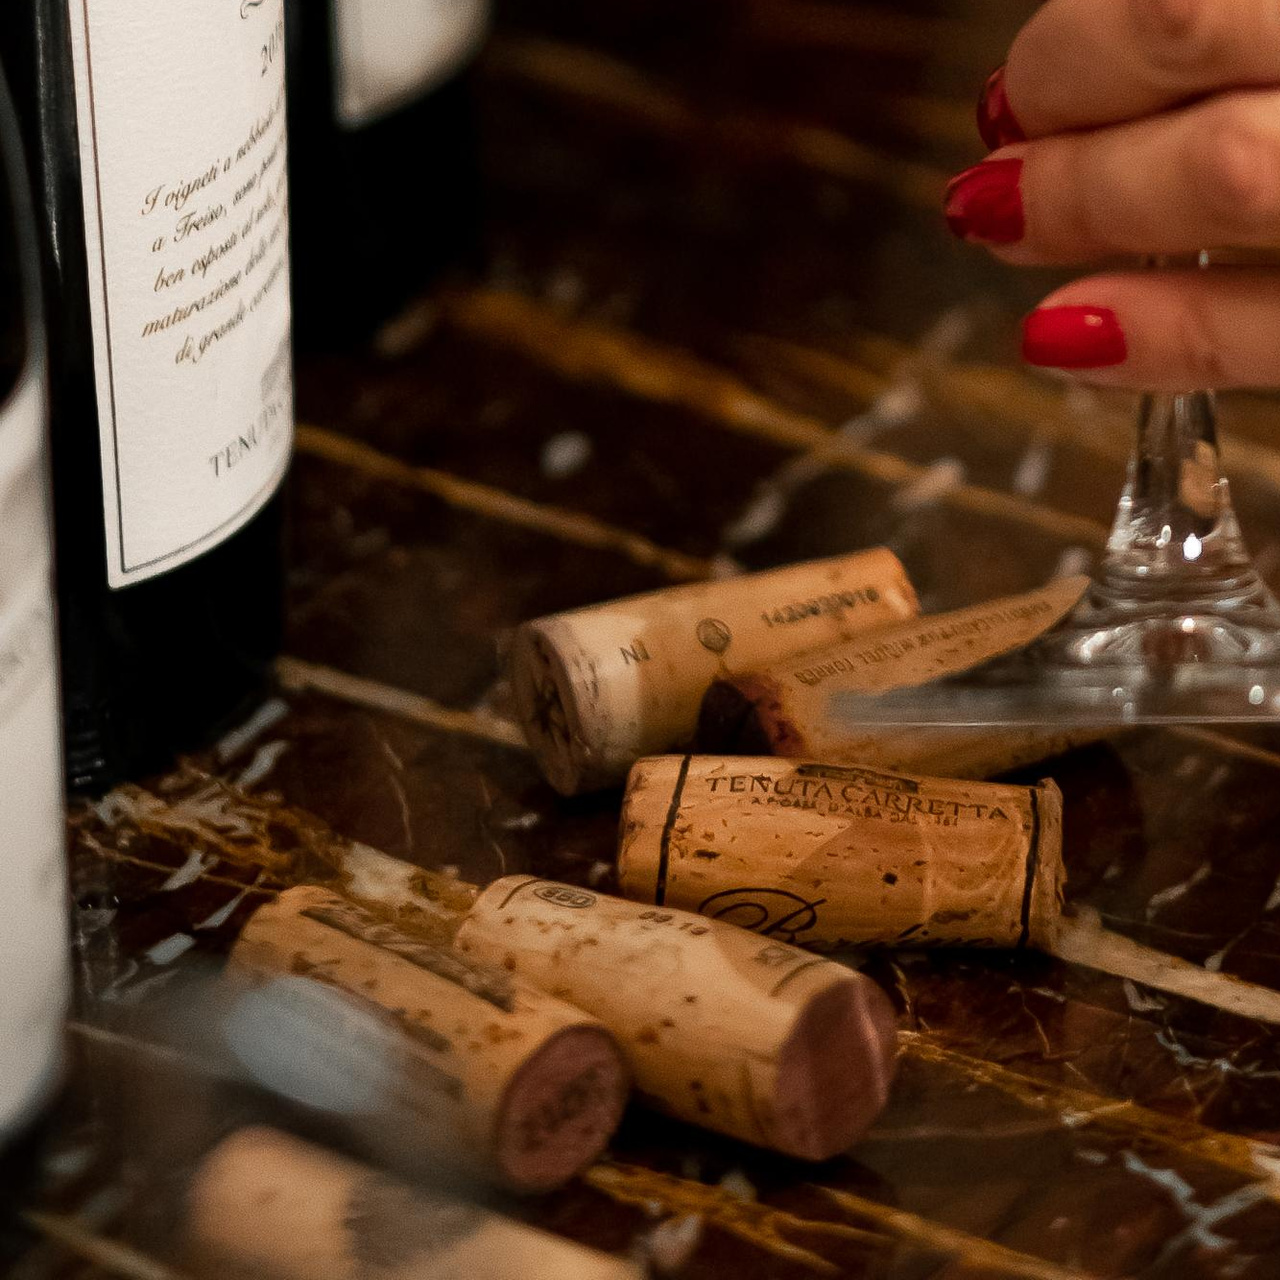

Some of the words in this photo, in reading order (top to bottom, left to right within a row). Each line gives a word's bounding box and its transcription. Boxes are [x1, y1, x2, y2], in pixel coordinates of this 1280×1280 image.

[153, 265, 185, 293] ben
[705, 773, 833, 800] TENUTA
[841, 784, 1009, 821] CARRETTA
